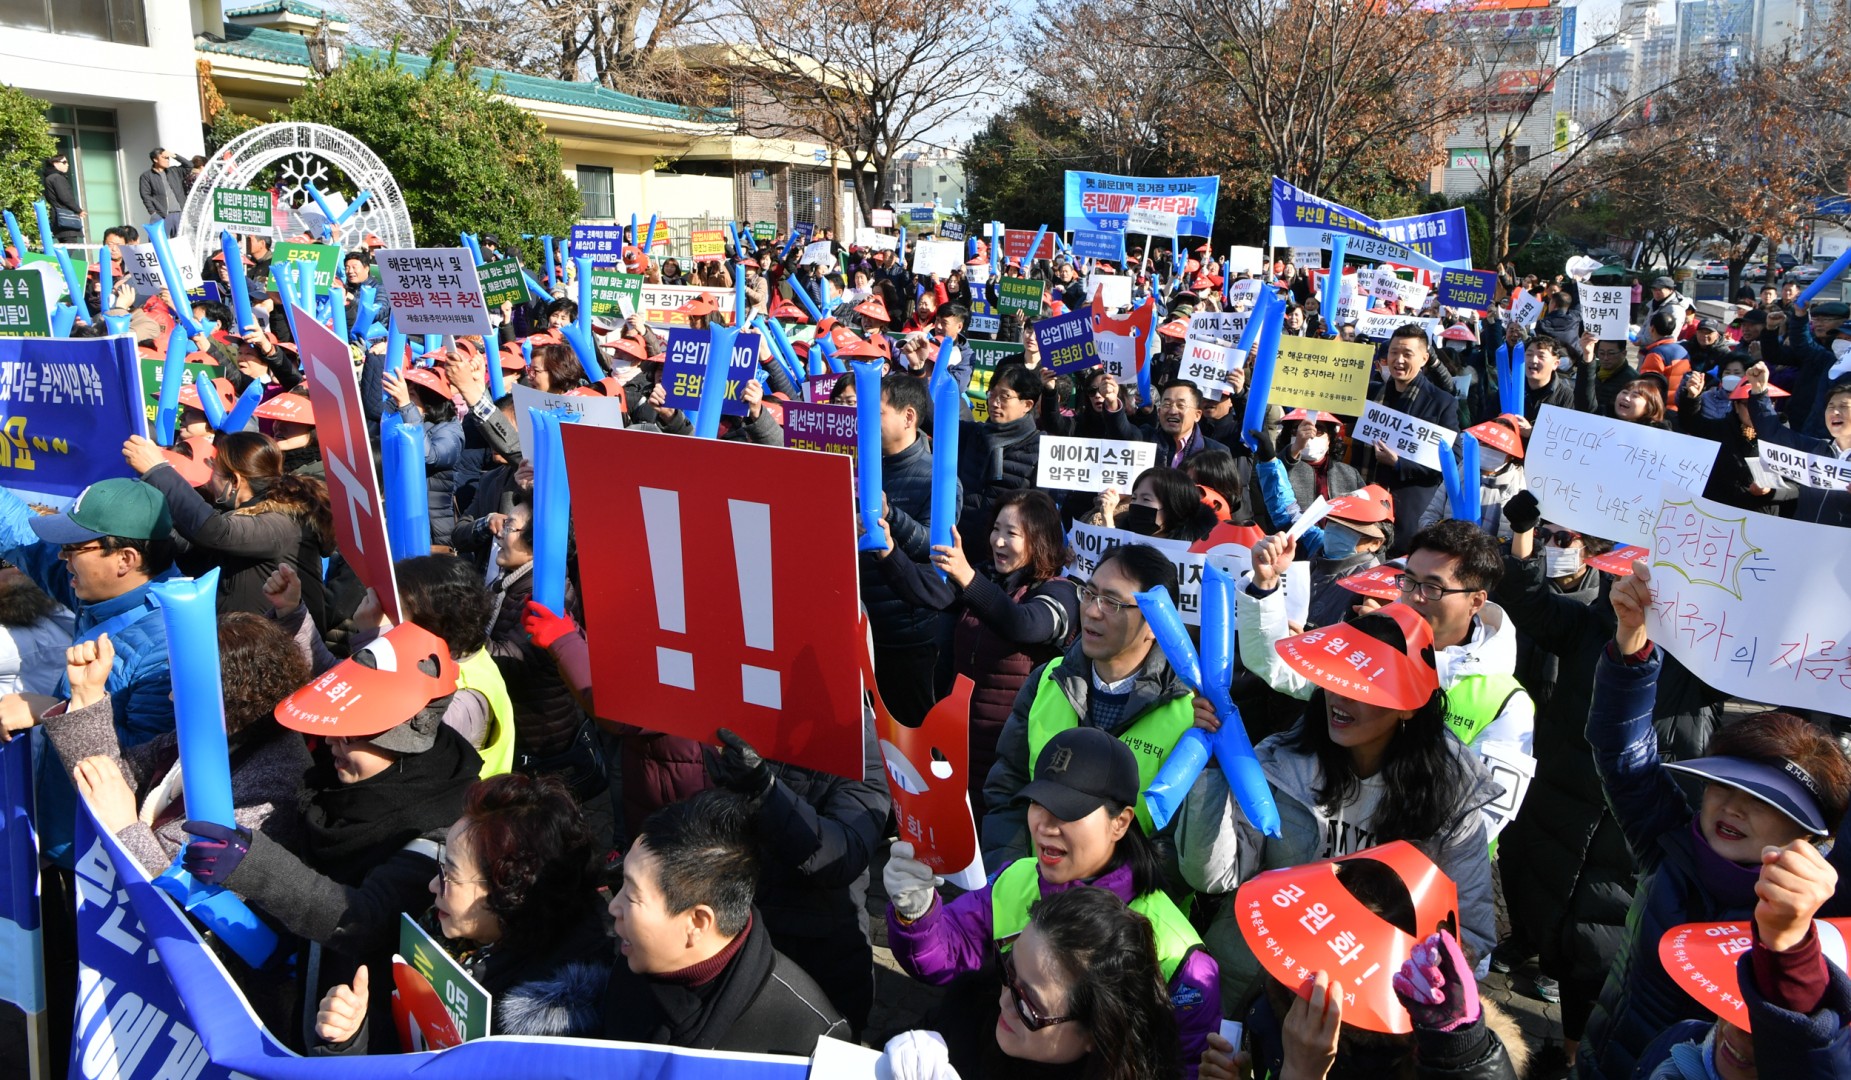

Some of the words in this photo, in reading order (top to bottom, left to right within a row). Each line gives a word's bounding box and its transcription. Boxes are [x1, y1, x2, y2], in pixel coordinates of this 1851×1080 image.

[1097, 179, 1134, 191] 해운대역
[1136, 182, 1165, 193] 정거장
[1168, 183, 1197, 193] 부지는
[1083, 193, 1135, 214] 주민에게
[1295, 205, 1326, 224] 부산의
[1321, 232, 1409, 261] 해대시장상인회
[387, 257, 444, 272] 해운대역사
[450, 257, 463, 272] 및
[3, 278, 15, 299] 숲
[18, 278, 29, 299] 속
[398, 274, 432, 290] 정거장
[438, 275, 461, 290] 부지
[1444, 272, 1484, 288] 국토부는
[390, 291, 425, 309] 공원화
[428, 292, 452, 309] 적극
[457, 292, 482, 309] 추진
[1448, 288, 1488, 306] 각성하라
[1592, 291, 1623, 304] 소원은
[1583, 305, 1619, 321] 거장부지
[1040, 318, 1083, 347] 상업개발
[1585, 322, 1602, 336] 원화
[671, 340, 711, 367] 상업개
[1050, 343, 1084, 368] 공원화
[1192, 346, 1225, 365] NO!!!
[1287, 351, 1329, 364] 해운대역의
[1332, 357, 1366, 370] 상업화를
[0, 361, 37, 403] 겠다는
[39, 362, 84, 406] 부산시의
[1281, 365, 1298, 377] 즉각
[1302, 368, 1335, 381] 중지하라
[673, 372, 702, 398] 공원
[788, 409, 825, 436] 폐선부지
[826, 411, 858, 438] 무상양
[1362, 424, 1391, 444] 입주민
[1395, 437, 1420, 455] 일동
[1049, 465, 1091, 483] 입주민
[1101, 469, 1129, 486] 일동
[1810, 474, 1833, 489] 일동
[1530, 475, 1583, 513] 이제는
[1637, 506, 1656, 535] 함
[1076, 554, 1099, 576] 입주
[638, 485, 782, 711] !!
[1301, 631, 1385, 683] 공원화!
[307, 672, 363, 712] 원화!
[1352, 682, 1370, 694] 부지
[1250, 909, 1269, 937] 해운대
[1265, 936, 1284, 958] 역사
[1282, 955, 1297, 970] 및
[1271, 883, 1381, 987] 공원화!
[1705, 924, 1753, 967] 공원
[1690, 971, 1719, 993] 정거장
[1719, 991, 1744, 1010] 부지
